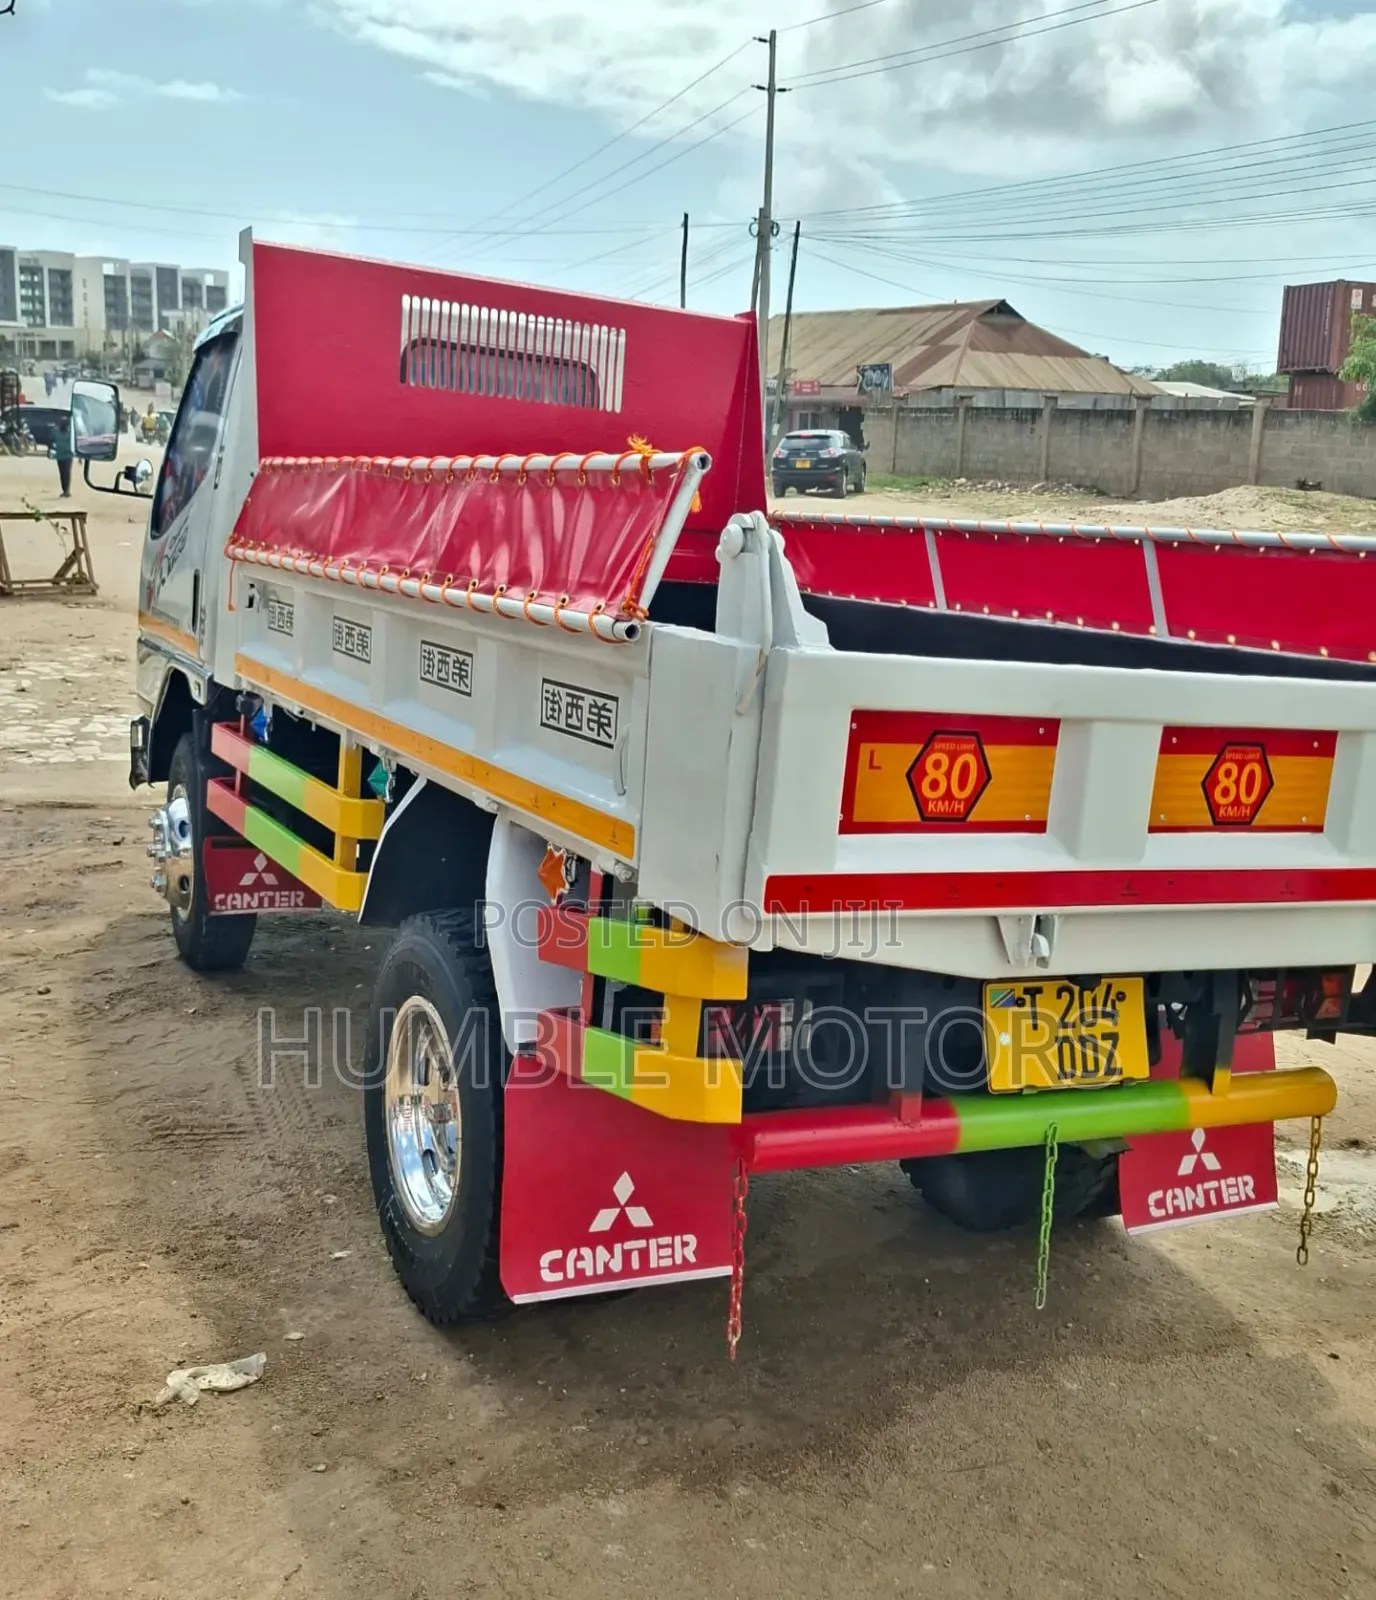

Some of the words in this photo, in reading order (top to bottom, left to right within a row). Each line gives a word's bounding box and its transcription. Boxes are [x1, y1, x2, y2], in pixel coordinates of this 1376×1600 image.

[933, 742, 956, 751] SPEED
[957, 743, 975, 751] LIMIT
[1225, 752, 1244, 760] SPEED
[868, 748, 882, 770] L
[921, 752, 978, 799] 80
[1214, 762, 1262, 805] 80
[927, 800, 965, 813] KM/H
[1218, 805, 1251, 818] KM/H
[213, 890, 305, 911] CANTER
[1022, 986, 1044, 1031] T
[1055, 983, 1119, 1030] 204
[1147, 1174, 1256, 1218] CANTER
[539, 1233, 698, 1283] CANTER
